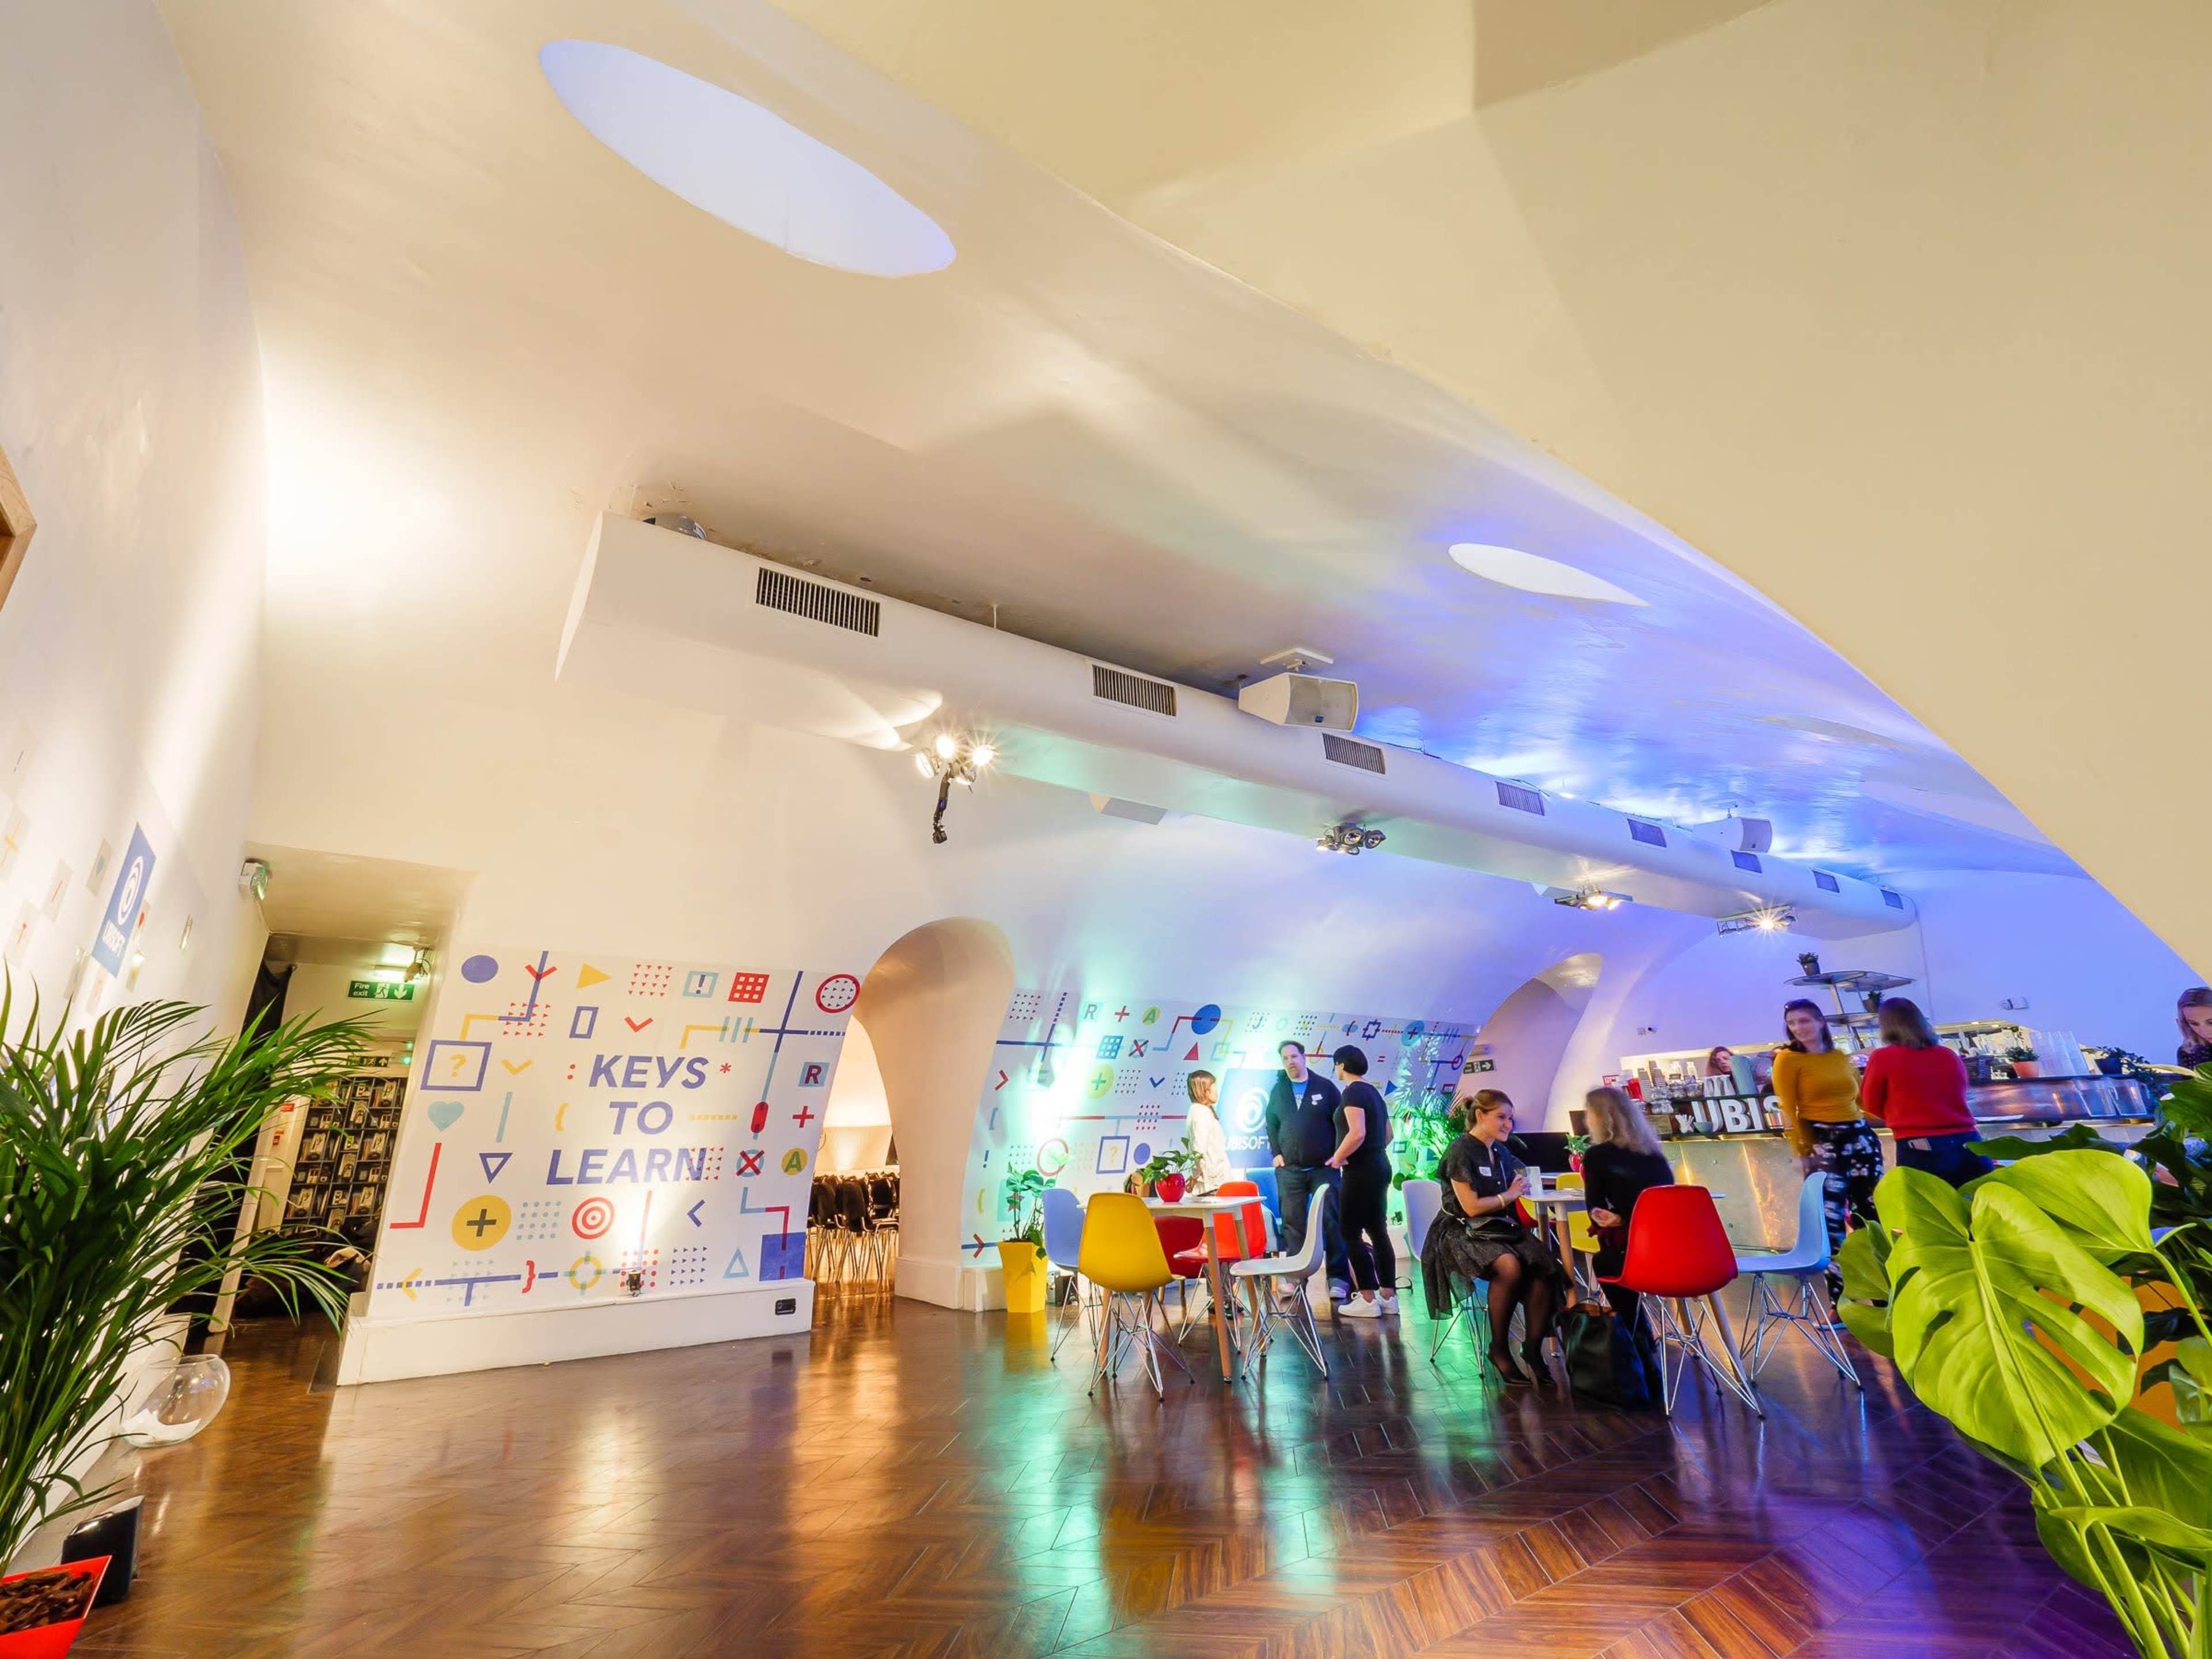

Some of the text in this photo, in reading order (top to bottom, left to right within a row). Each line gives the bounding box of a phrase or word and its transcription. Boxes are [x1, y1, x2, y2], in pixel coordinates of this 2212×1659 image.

[589, 1054, 709, 1089] KEYS
[804, 1065, 822, 1084] R
[608, 1101, 673, 1135] TO
[546, 1147, 707, 1185] LEARN
[783, 1152, 802, 1173] A
